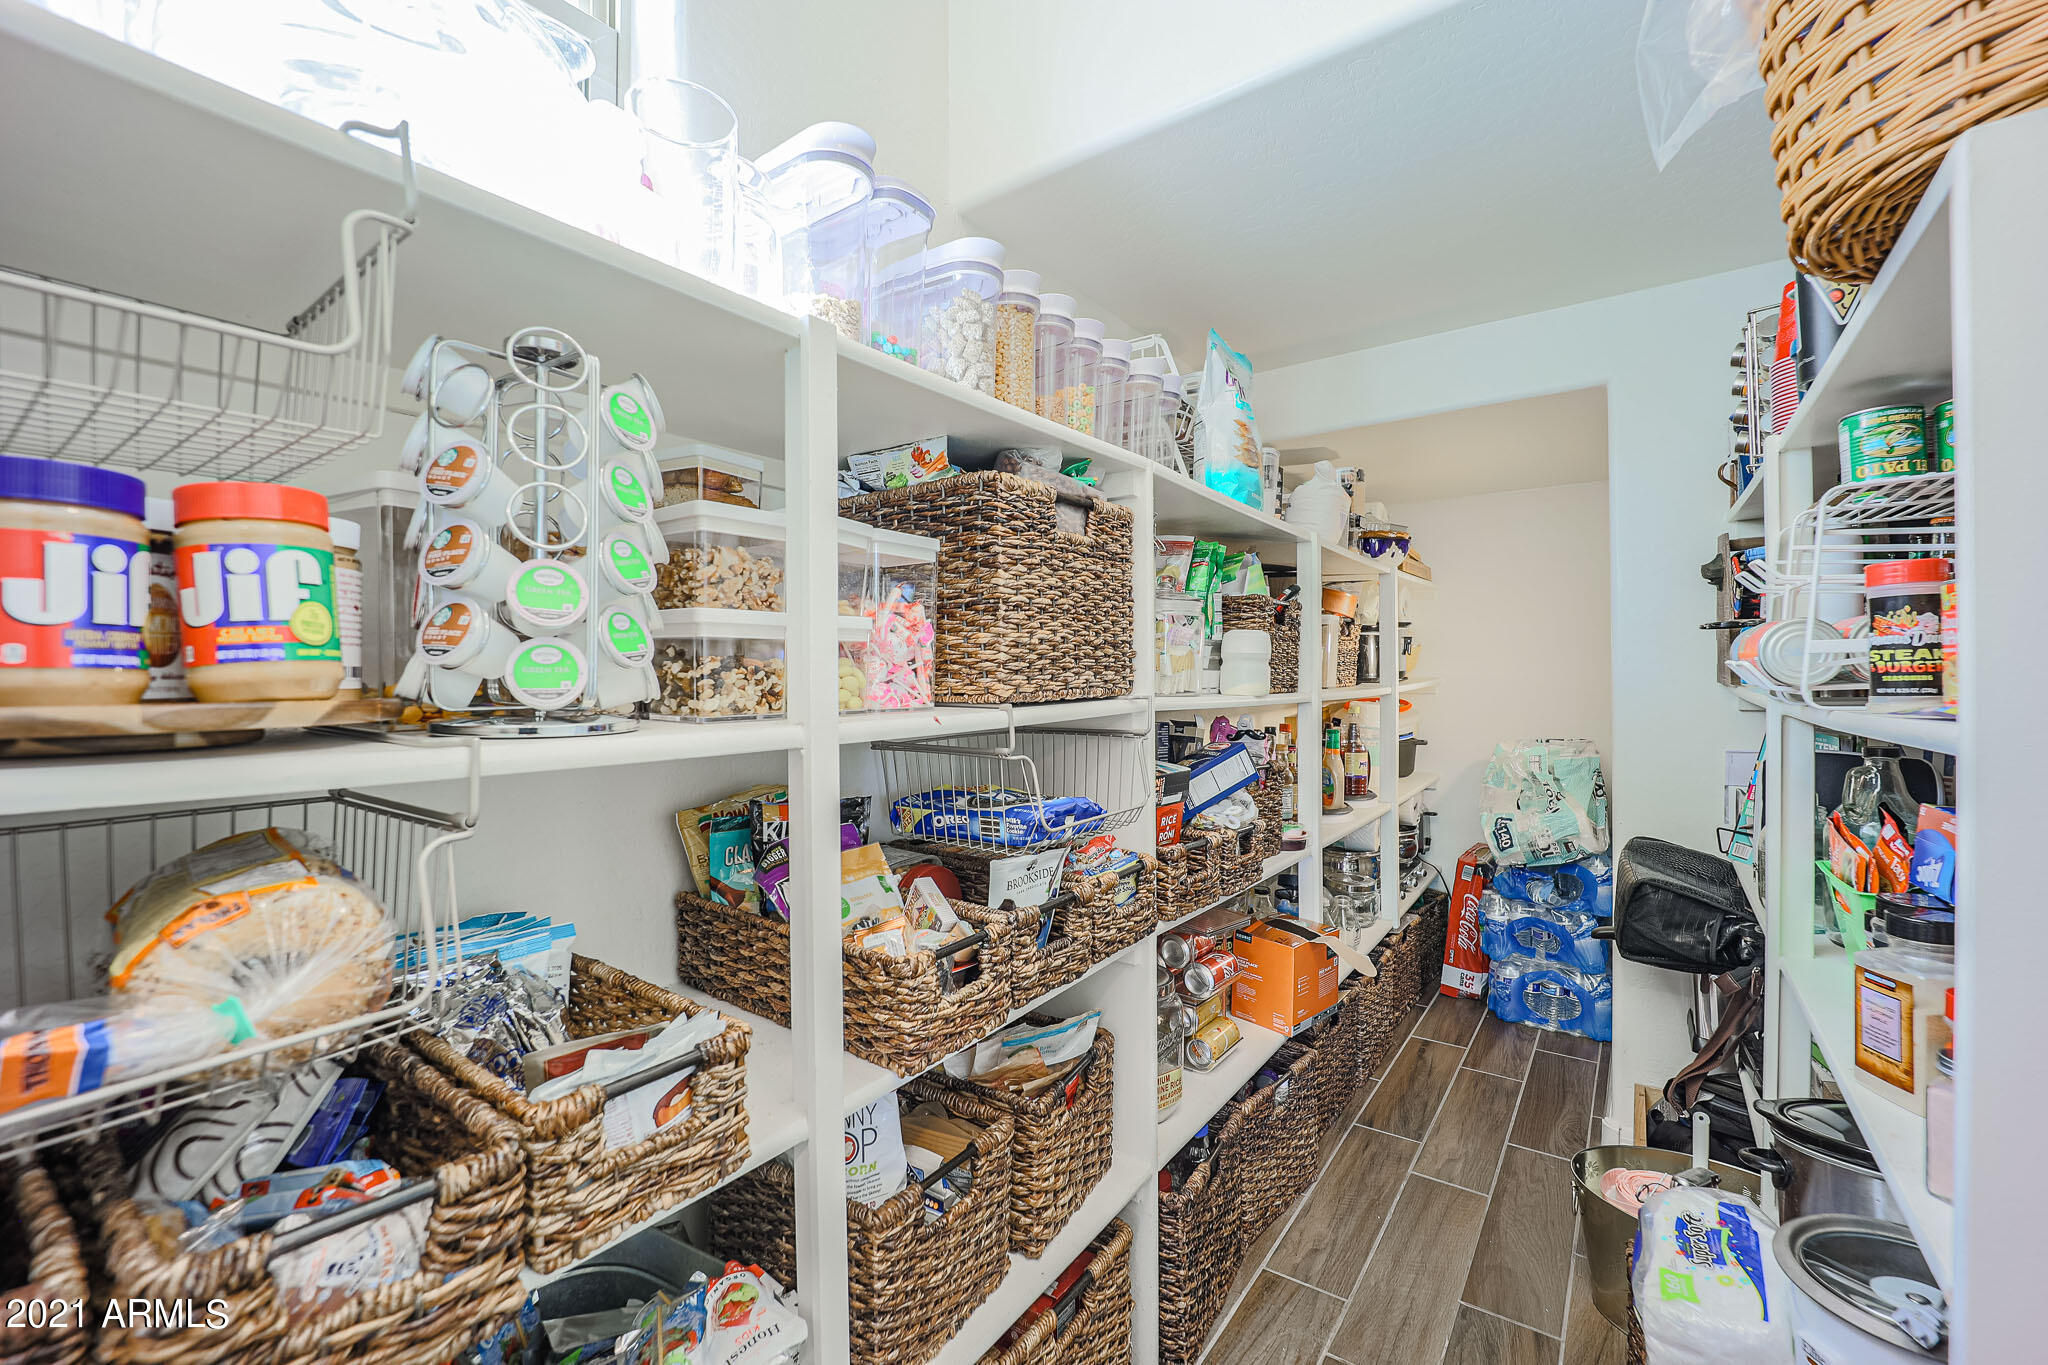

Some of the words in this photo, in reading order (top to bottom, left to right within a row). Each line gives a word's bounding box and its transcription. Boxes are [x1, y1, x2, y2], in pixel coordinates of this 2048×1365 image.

[1855, 460, 1911, 479] PATO
[179, 547, 323, 628] Jif
[933, 814, 970, 828] OREO
[1005, 822, 1028, 830] Favorite
[1160, 813, 1178, 827] RICE
[1158, 828, 1176, 842] RONI
[760, 847, 788, 868] BIGGER
[1006, 866, 1054, 891] BROOKSIDE
[1464, 973, 1475, 990] 35
[1681, 1208, 1712, 1242] Soft
[1688, 1240, 1717, 1269] Super
[734, 1323, 761, 1347] KIDS
